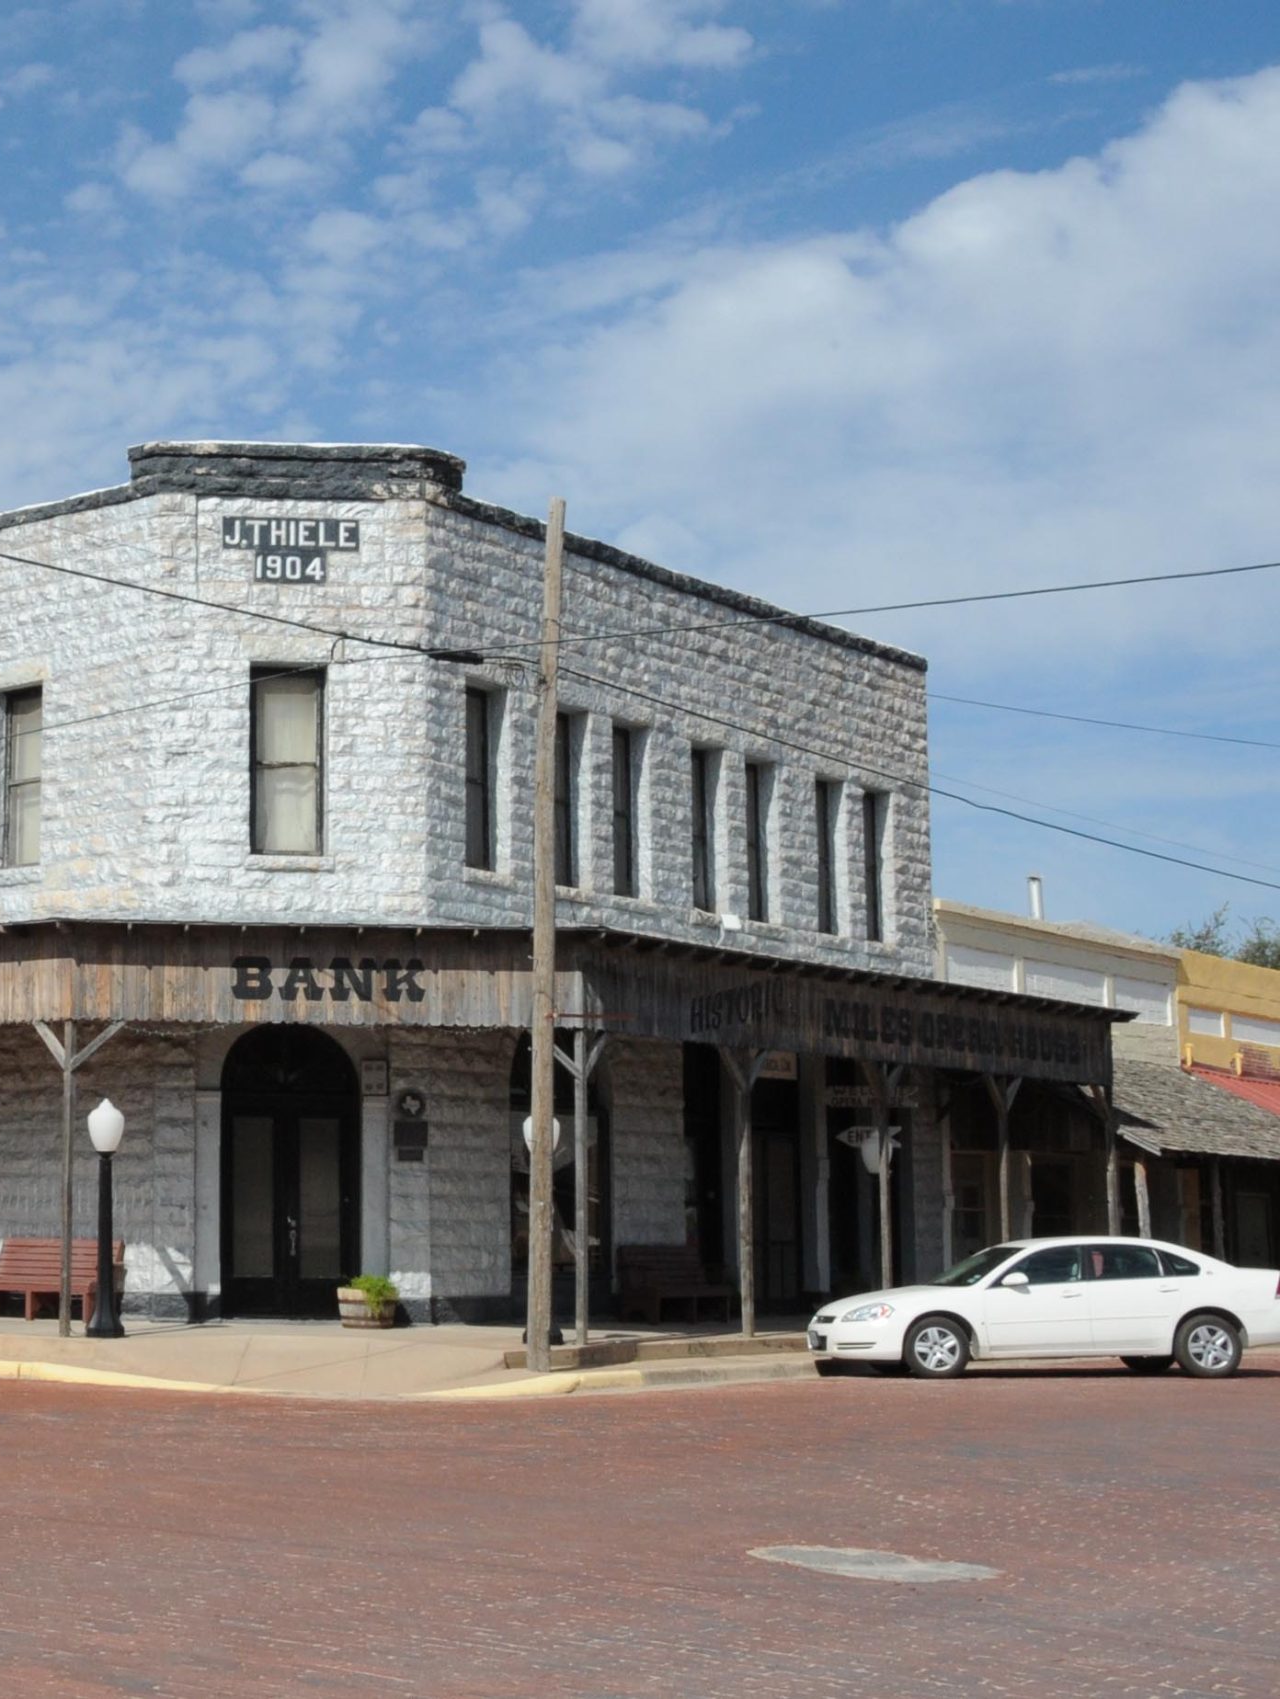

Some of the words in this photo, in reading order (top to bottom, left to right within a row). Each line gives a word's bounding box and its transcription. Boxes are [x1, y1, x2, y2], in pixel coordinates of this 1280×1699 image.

[256, 555, 325, 581] 1904
[231, 956, 426, 1002] BANK
[690, 977, 783, 1033] HISTORIC
[824, 999, 912, 1046] MILES
[919, 1012, 1003, 1056] OPERA
